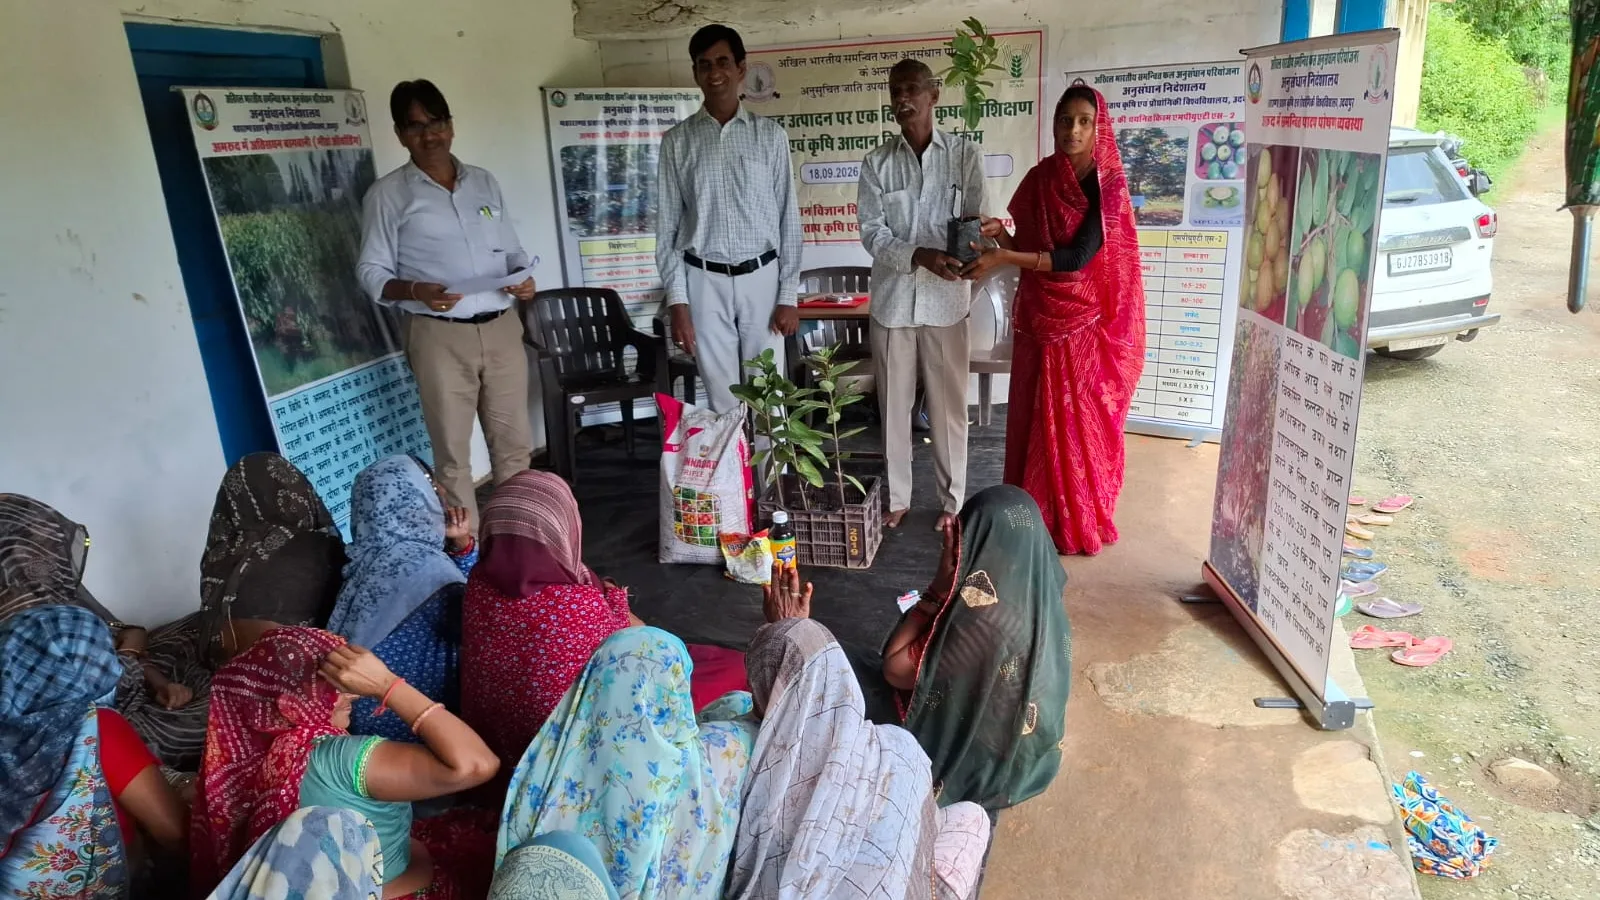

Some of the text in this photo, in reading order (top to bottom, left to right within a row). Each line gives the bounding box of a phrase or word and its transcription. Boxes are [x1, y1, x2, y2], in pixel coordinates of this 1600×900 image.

[778, 56, 807, 68] अखिल
[809, 53, 841, 65] भारतीय
[843, 50, 877, 63] समन्वित
[880, 51, 898, 60] फल
[801, 83, 840, 98] अनुसूचित
[842, 81, 863, 93] जाति
[1122, 81, 1206, 98] अनुसंधान निदेशालय
[1281, 73, 1307, 93] अनुसंधान
[787, 112, 833, 128] उत्पादन
[835, 110, 853, 125] पर
[856, 109, 880, 124] एक
[789, 133, 805, 153] एवं
[807, 133, 834, 157] कृषि
[837, 135, 880, 151] आदान
[813, 203, 845, 216] विज्ञान
[823, 220, 845, 236] कृषि
[1328, 442, 1347, 461] तथा
[1310, 481, 1319, 496] 50
[1301, 576, 1313, 596] 250
